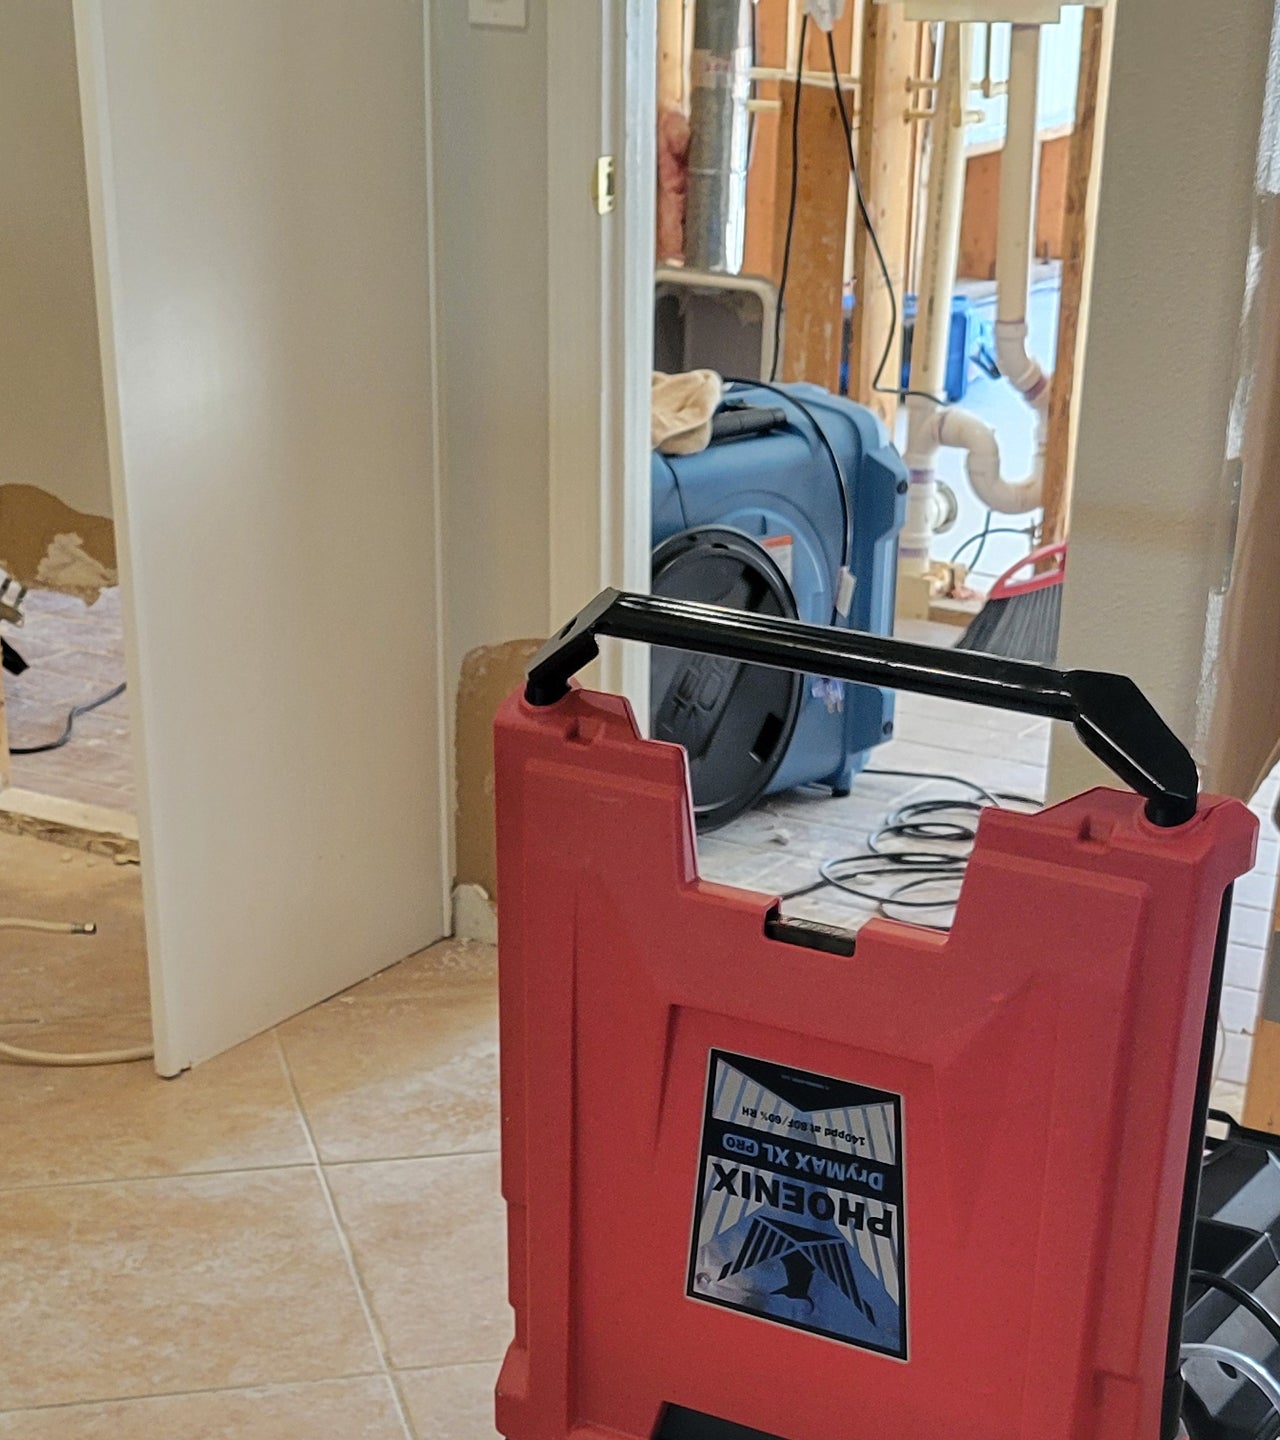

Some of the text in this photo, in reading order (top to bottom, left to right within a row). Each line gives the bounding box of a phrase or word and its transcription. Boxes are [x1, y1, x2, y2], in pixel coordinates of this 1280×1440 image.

[742, 1106, 758, 1119] RH
[810, 1123, 822, 1135] at
[824, 1127, 866, 1147] 140ppd
[726, 1136, 885, 1191] DryMAX XL PRO
[712, 1162, 893, 1239] PHOENIX
